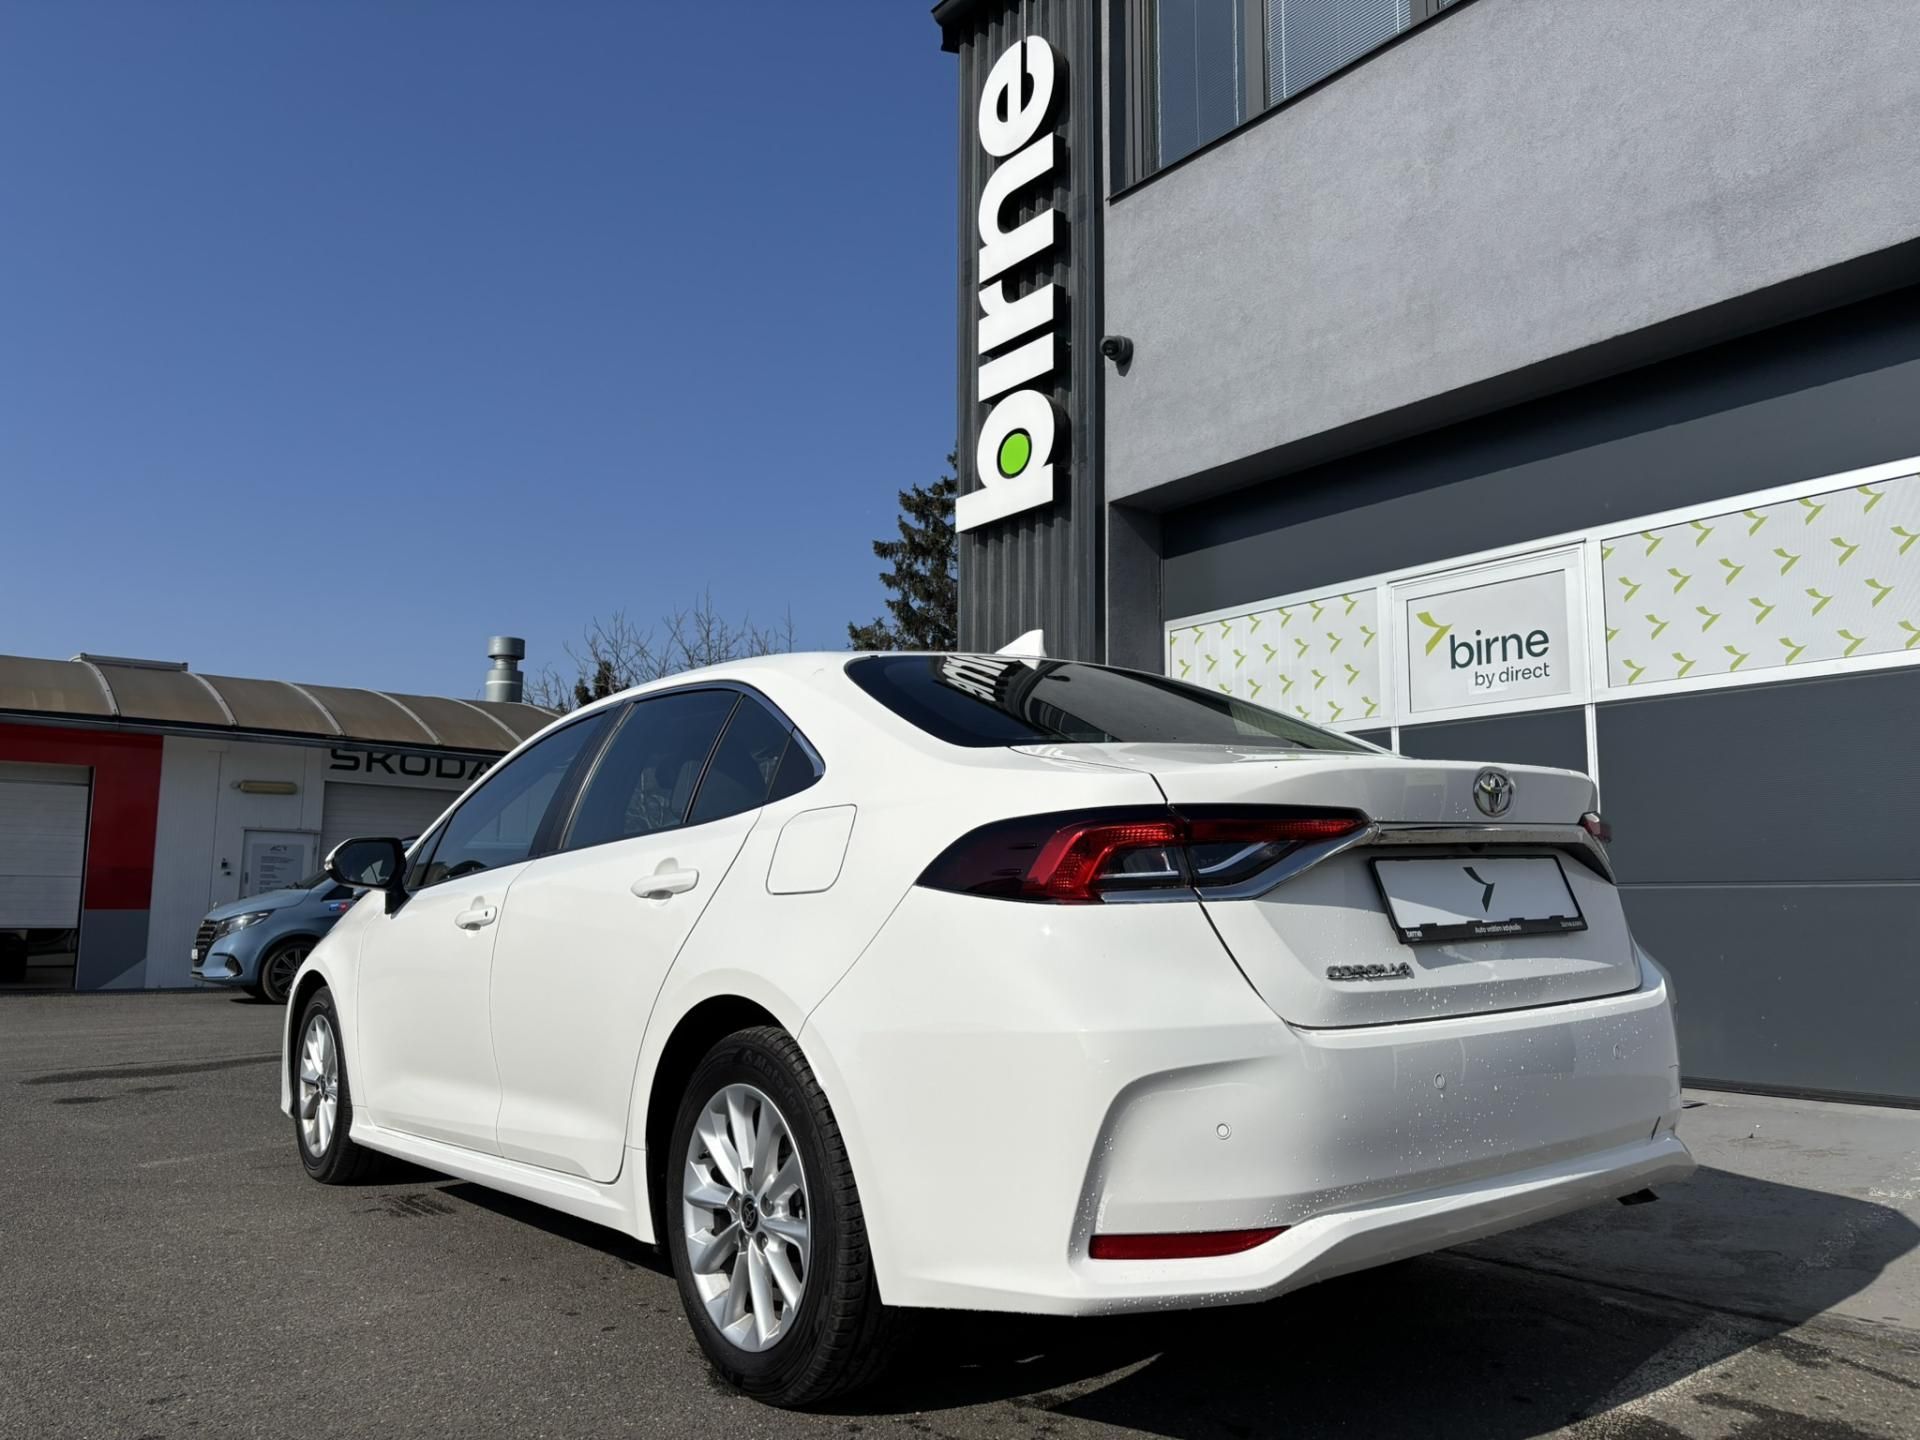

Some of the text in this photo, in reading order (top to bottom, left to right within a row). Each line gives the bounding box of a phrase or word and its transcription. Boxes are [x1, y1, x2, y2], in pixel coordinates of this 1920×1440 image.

[955, 34, 1055, 533] birne
[1449, 629, 1550, 669] birne
[1475, 662, 1550, 689] by direct
[1326, 962, 1415, 982] COROLLA
